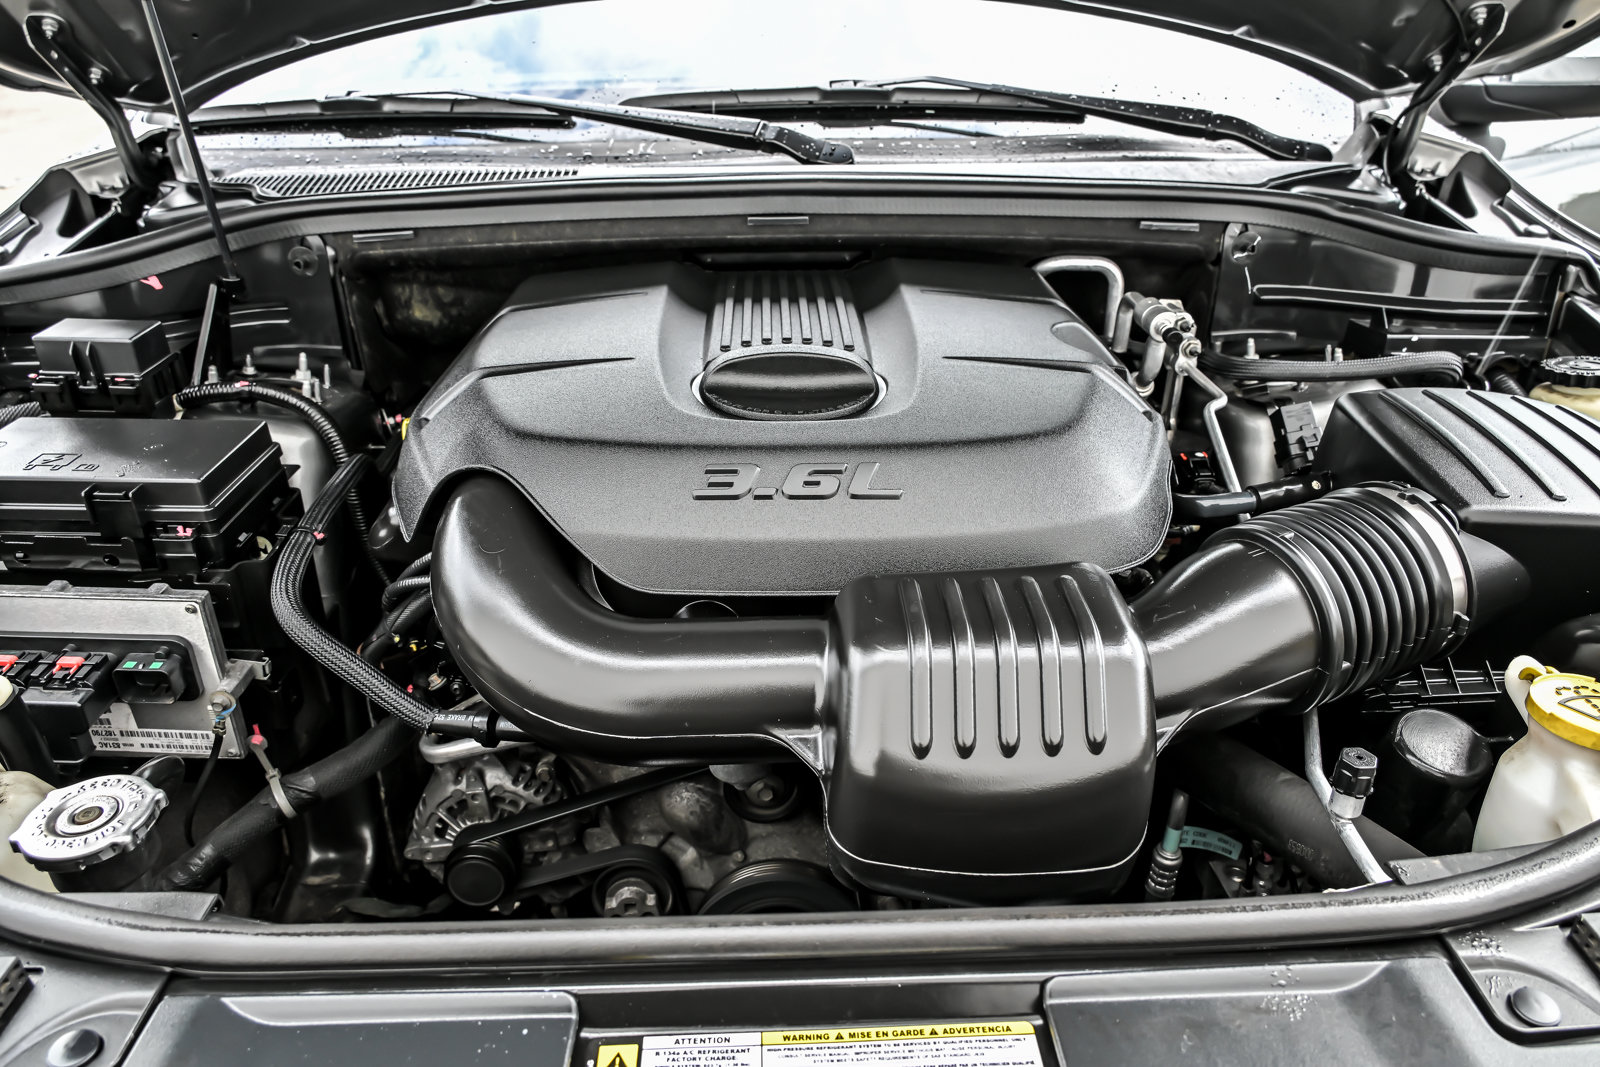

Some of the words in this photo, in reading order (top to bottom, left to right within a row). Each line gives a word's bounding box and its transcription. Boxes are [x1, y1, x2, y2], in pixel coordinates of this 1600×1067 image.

[692, 462, 904, 500] 3.6L
[782, 1033, 830, 1041] WARNING
[848, 1031, 872, 1039] MISE
[891, 1029, 926, 1037] GARDE
[942, 1025, 1013, 1035] ADVERTENCIA
[674, 1037, 731, 1045] ATTENTION
[697, 1047, 750, 1055] REFRIGERANT
